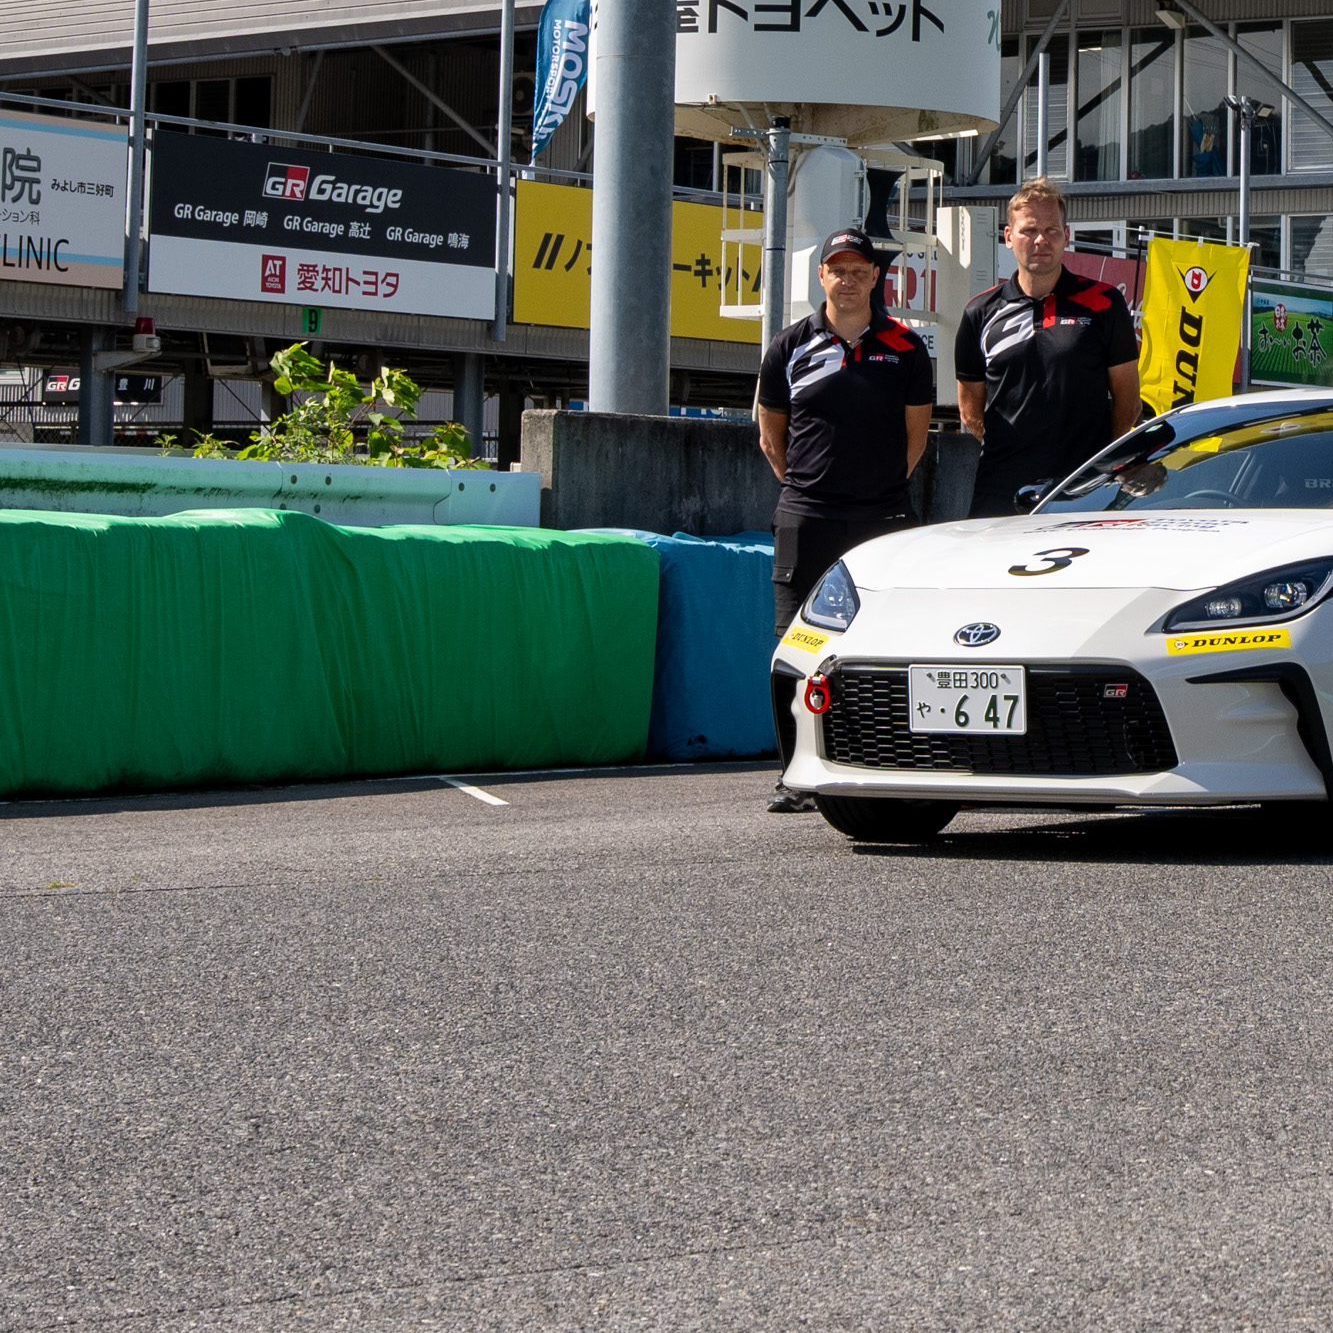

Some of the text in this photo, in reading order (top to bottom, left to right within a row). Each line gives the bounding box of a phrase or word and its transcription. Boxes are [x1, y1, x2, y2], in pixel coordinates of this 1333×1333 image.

[1, 147, 42, 205] 院
[51, 178, 114, 198] みよし市三好町
[265, 174, 403, 214] GR Garage
[0, 208, 40, 225] ション科
[174, 203, 269, 229] GR Garage 岡崎
[283, 215, 372, 240] GR Garage 高辻
[386, 226, 470, 250] GR Garage 鳴海
[0, 233, 70, 273] LINIC
[264, 259, 283, 277] AT
[297, 263, 400, 298] 愛知トヨタ
[308, 308, 318, 333] 9
[1007, 546, 1091, 577] 3
[792, 632, 825, 647] DUNLOP
[1191, 634, 1282, 648] DUNLOP
[1106, 688, 1127, 697] GR
